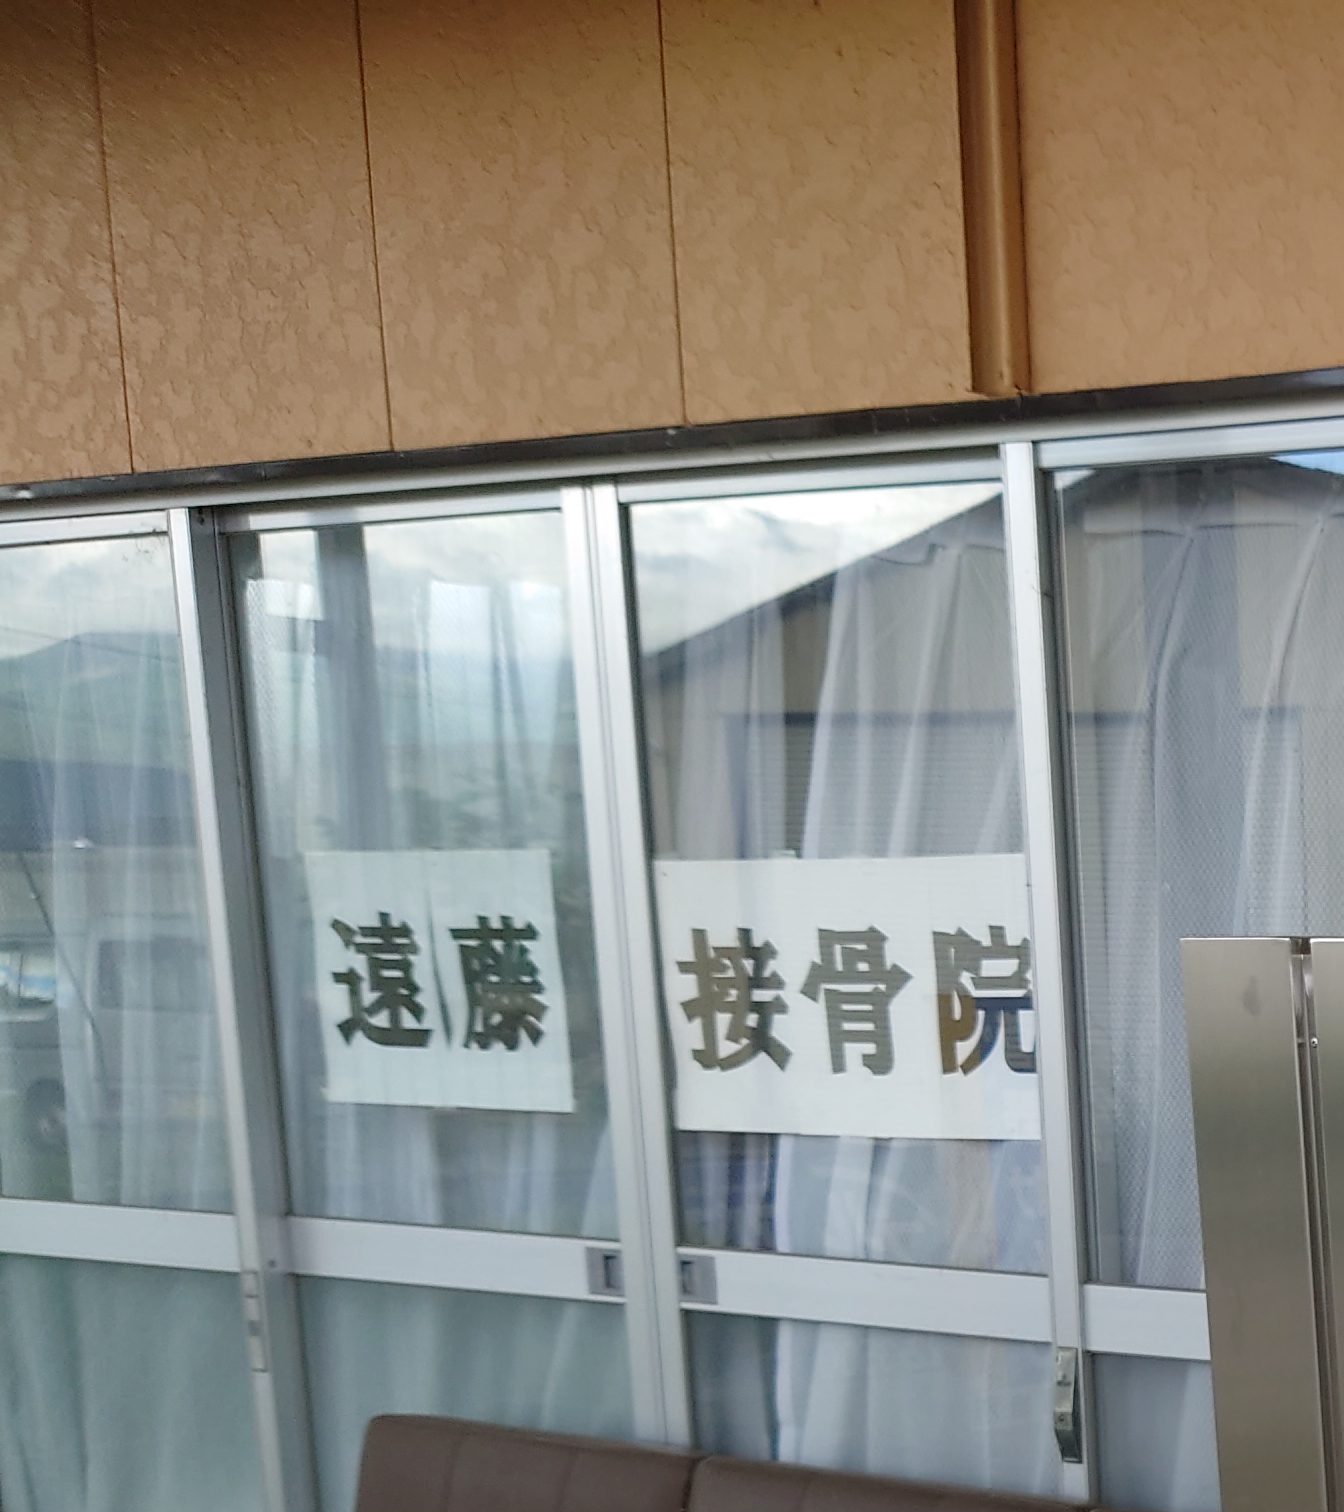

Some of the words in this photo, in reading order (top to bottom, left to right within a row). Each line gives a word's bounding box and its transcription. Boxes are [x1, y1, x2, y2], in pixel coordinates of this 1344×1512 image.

[331, 911, 549, 1051] 遠藤
[676, 925, 1037, 1077] 接骨院
